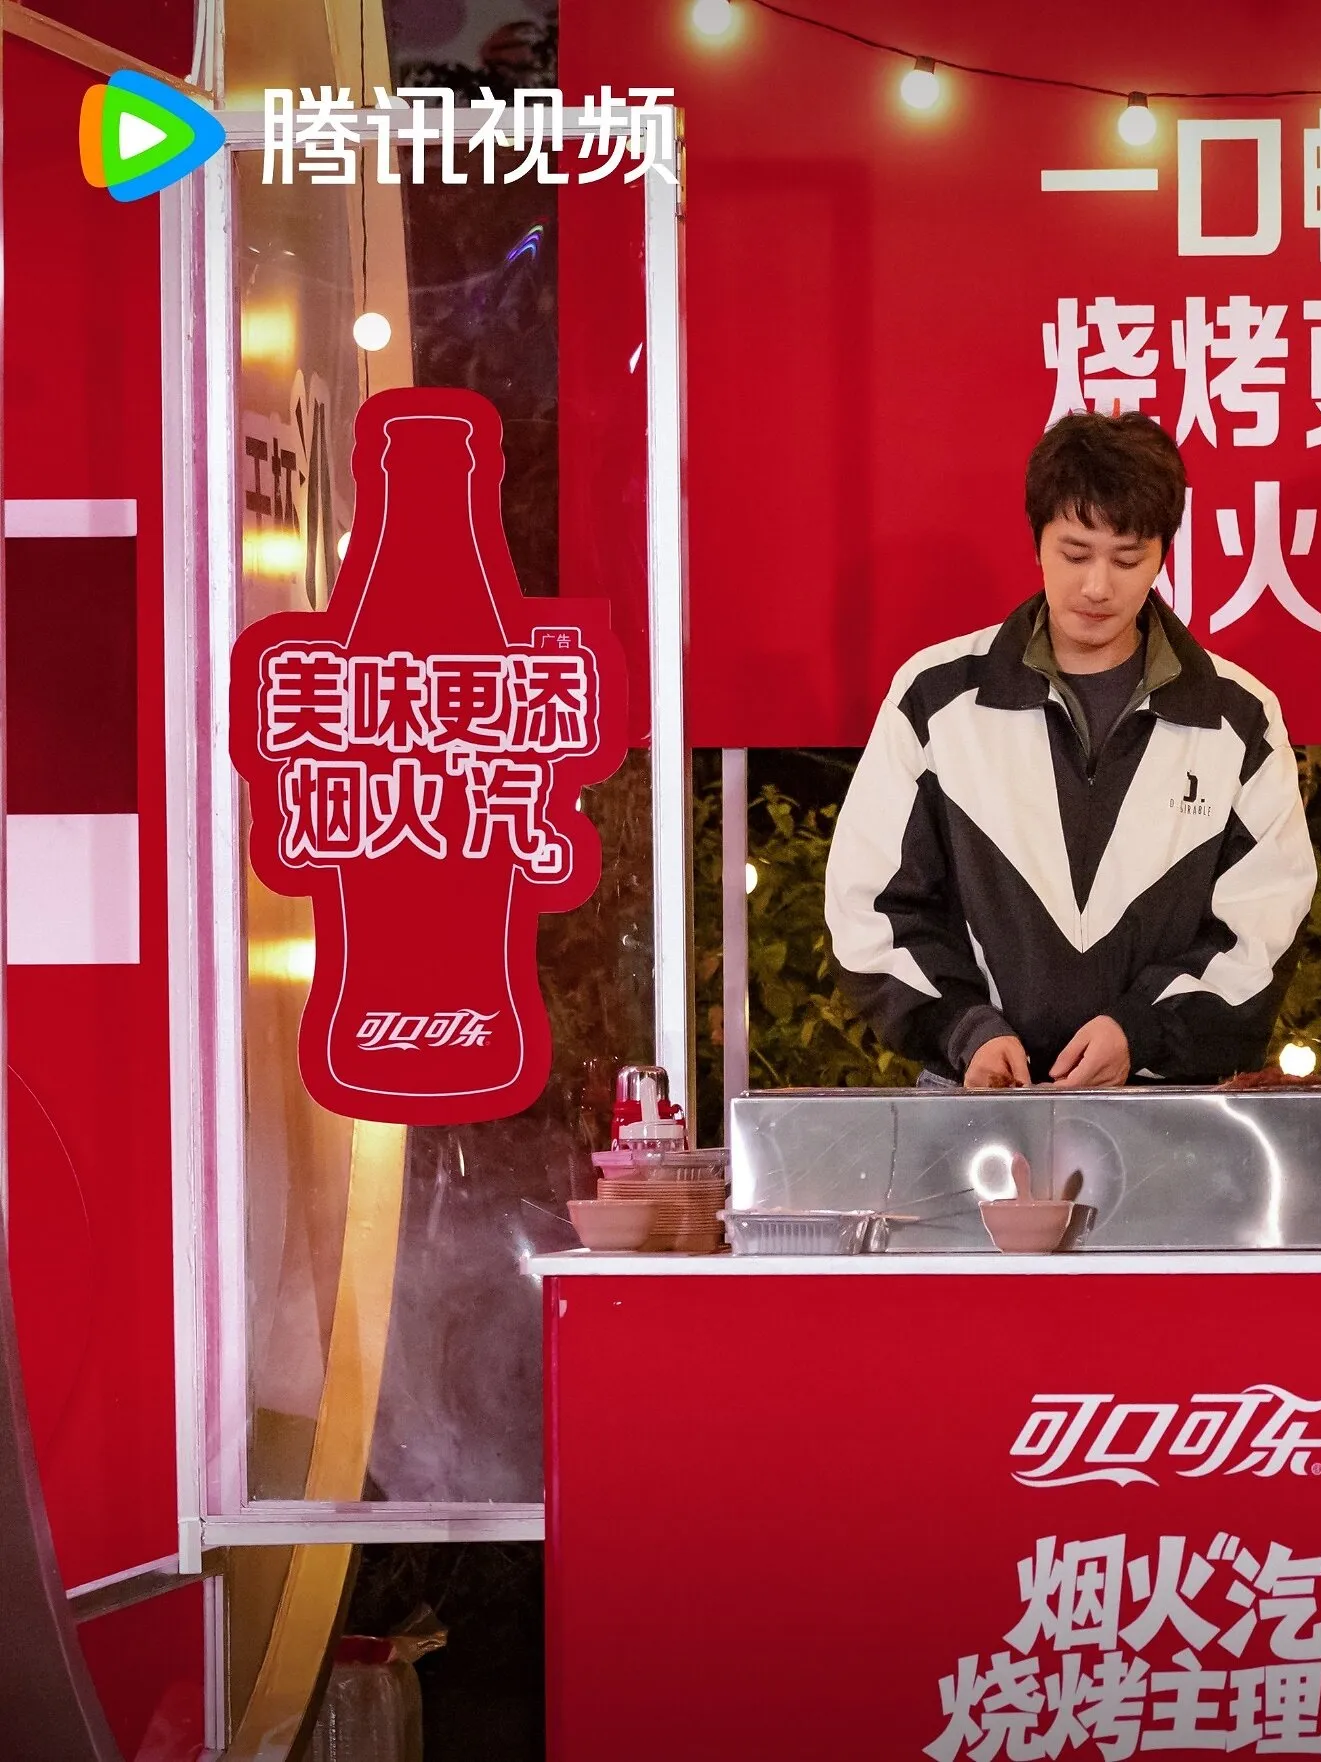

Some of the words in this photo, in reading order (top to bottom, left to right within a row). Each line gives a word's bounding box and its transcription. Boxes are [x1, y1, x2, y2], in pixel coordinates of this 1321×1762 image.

[540, 633, 571, 649] 广告
[267, 651, 589, 753] 美味更添
[355, 1008, 500, 1051] 可口可乐
